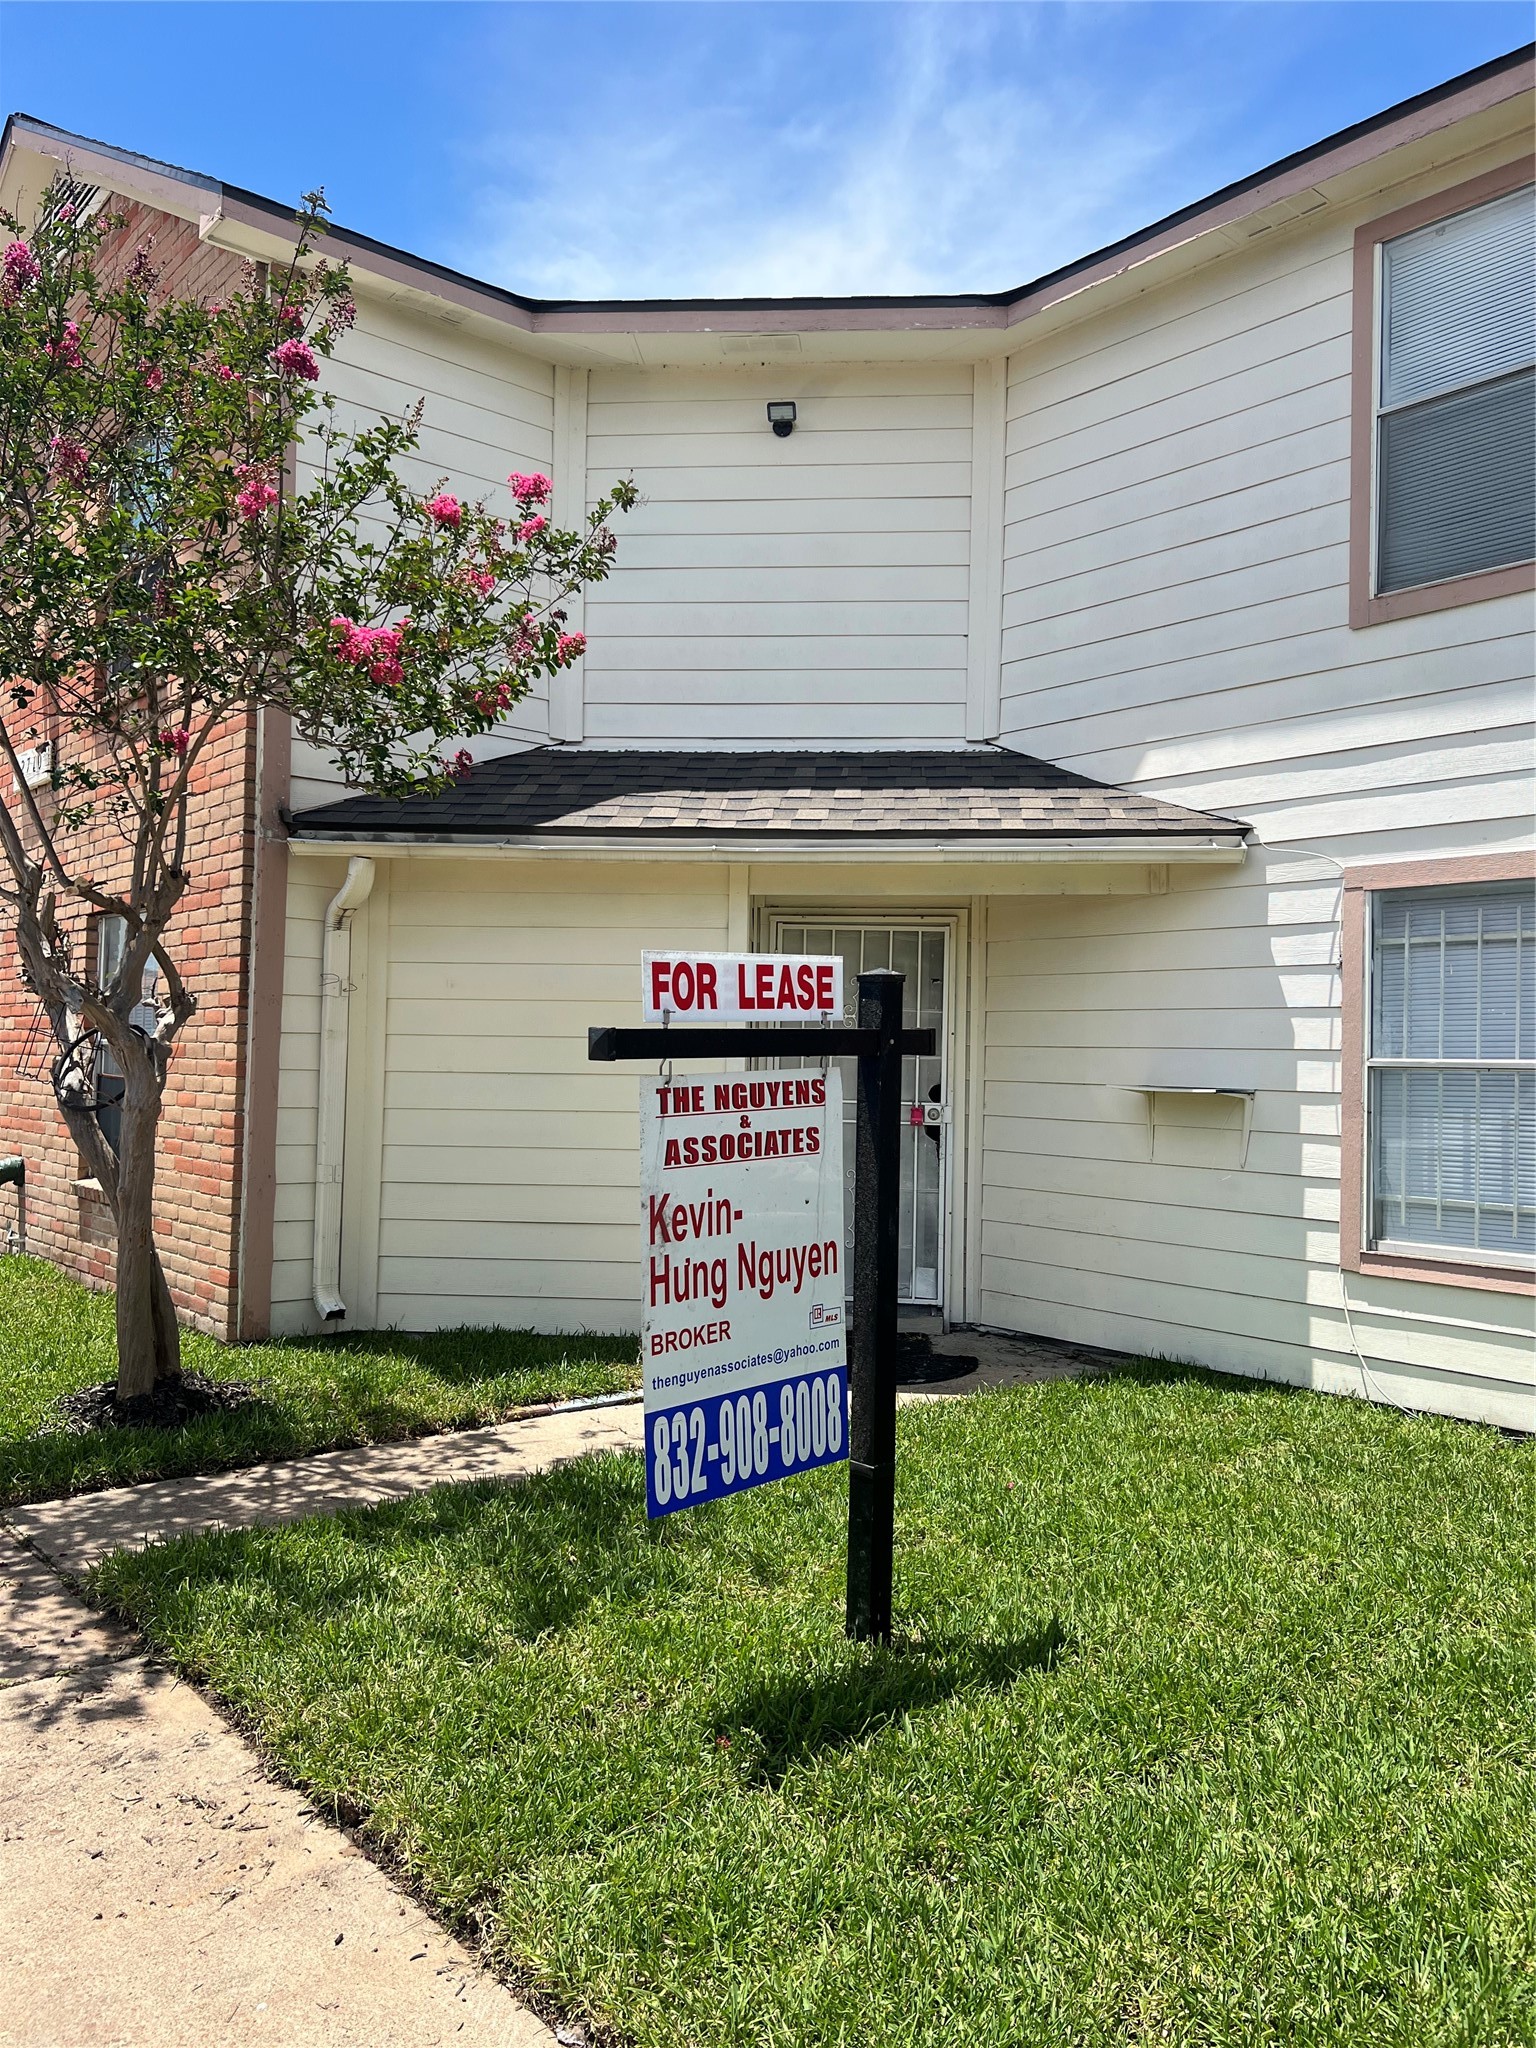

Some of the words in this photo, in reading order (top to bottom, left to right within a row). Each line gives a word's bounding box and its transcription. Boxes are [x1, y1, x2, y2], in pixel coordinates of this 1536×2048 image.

[651, 961, 718, 1010] FOR
[737, 963, 834, 1010] LEASE
[656, 1086, 704, 1115] THE
[714, 1079, 826, 1110] NGUYENS
[739, 1115, 752, 1129] &
[664, 1127, 820, 1167] ASSOCIATES
[649, 1188, 743, 1246] Kevin-
[738, 1240, 838, 1300] Nguyen
[651, 1320, 732, 1356] BROKER
[825, 1314, 839, 1322] MLS
[652, 1338, 840, 1390] thenguyenassociates@yahoo.com
[653, 1373, 842, 1505] 832-908-8008
